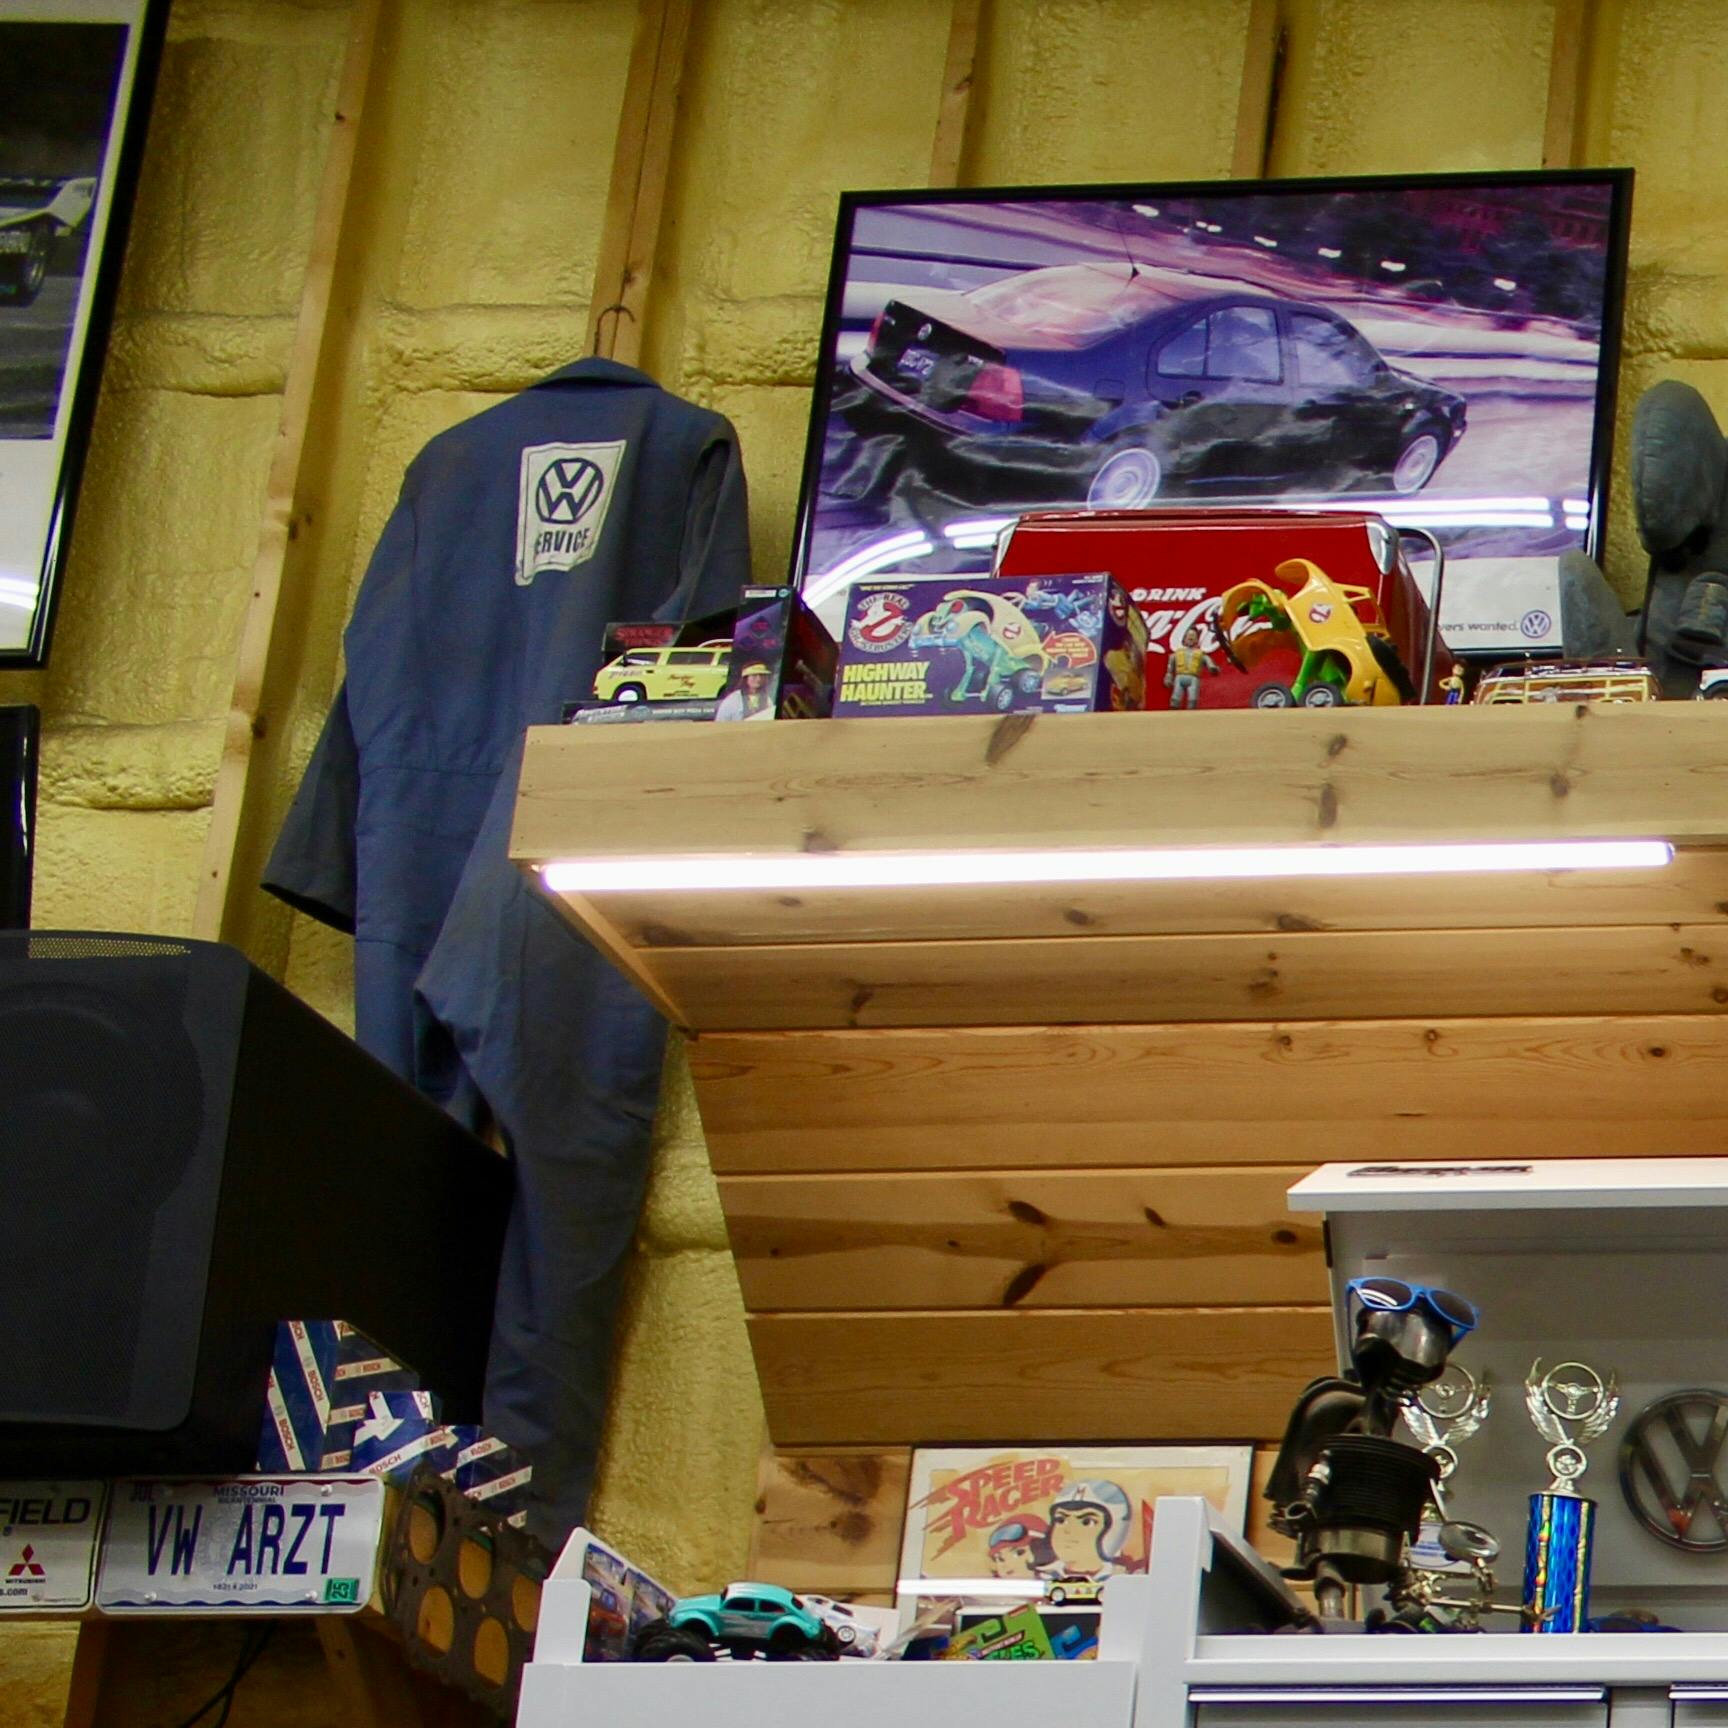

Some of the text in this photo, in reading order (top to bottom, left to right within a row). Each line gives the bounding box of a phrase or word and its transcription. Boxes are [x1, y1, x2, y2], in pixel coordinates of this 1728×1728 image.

[535, 528, 590, 554] ERVICE
[1130, 587, 1207, 602] DRINK
[1438, 620, 1518, 632] vers wanted.
[842, 661, 931, 683] HIGHWAY
[840, 681, 926, 703] HAUNTER
[307, 1369, 324, 1401] BOSCH
[278, 1418, 295, 1450] BOSCH
[213, 1485, 285, 1498] MISSOURI
[918, 1457, 1062, 1510] SPEED
[148, 1504, 346, 1576] VW ARZT
[331, 1580, 349, 1599] 25
